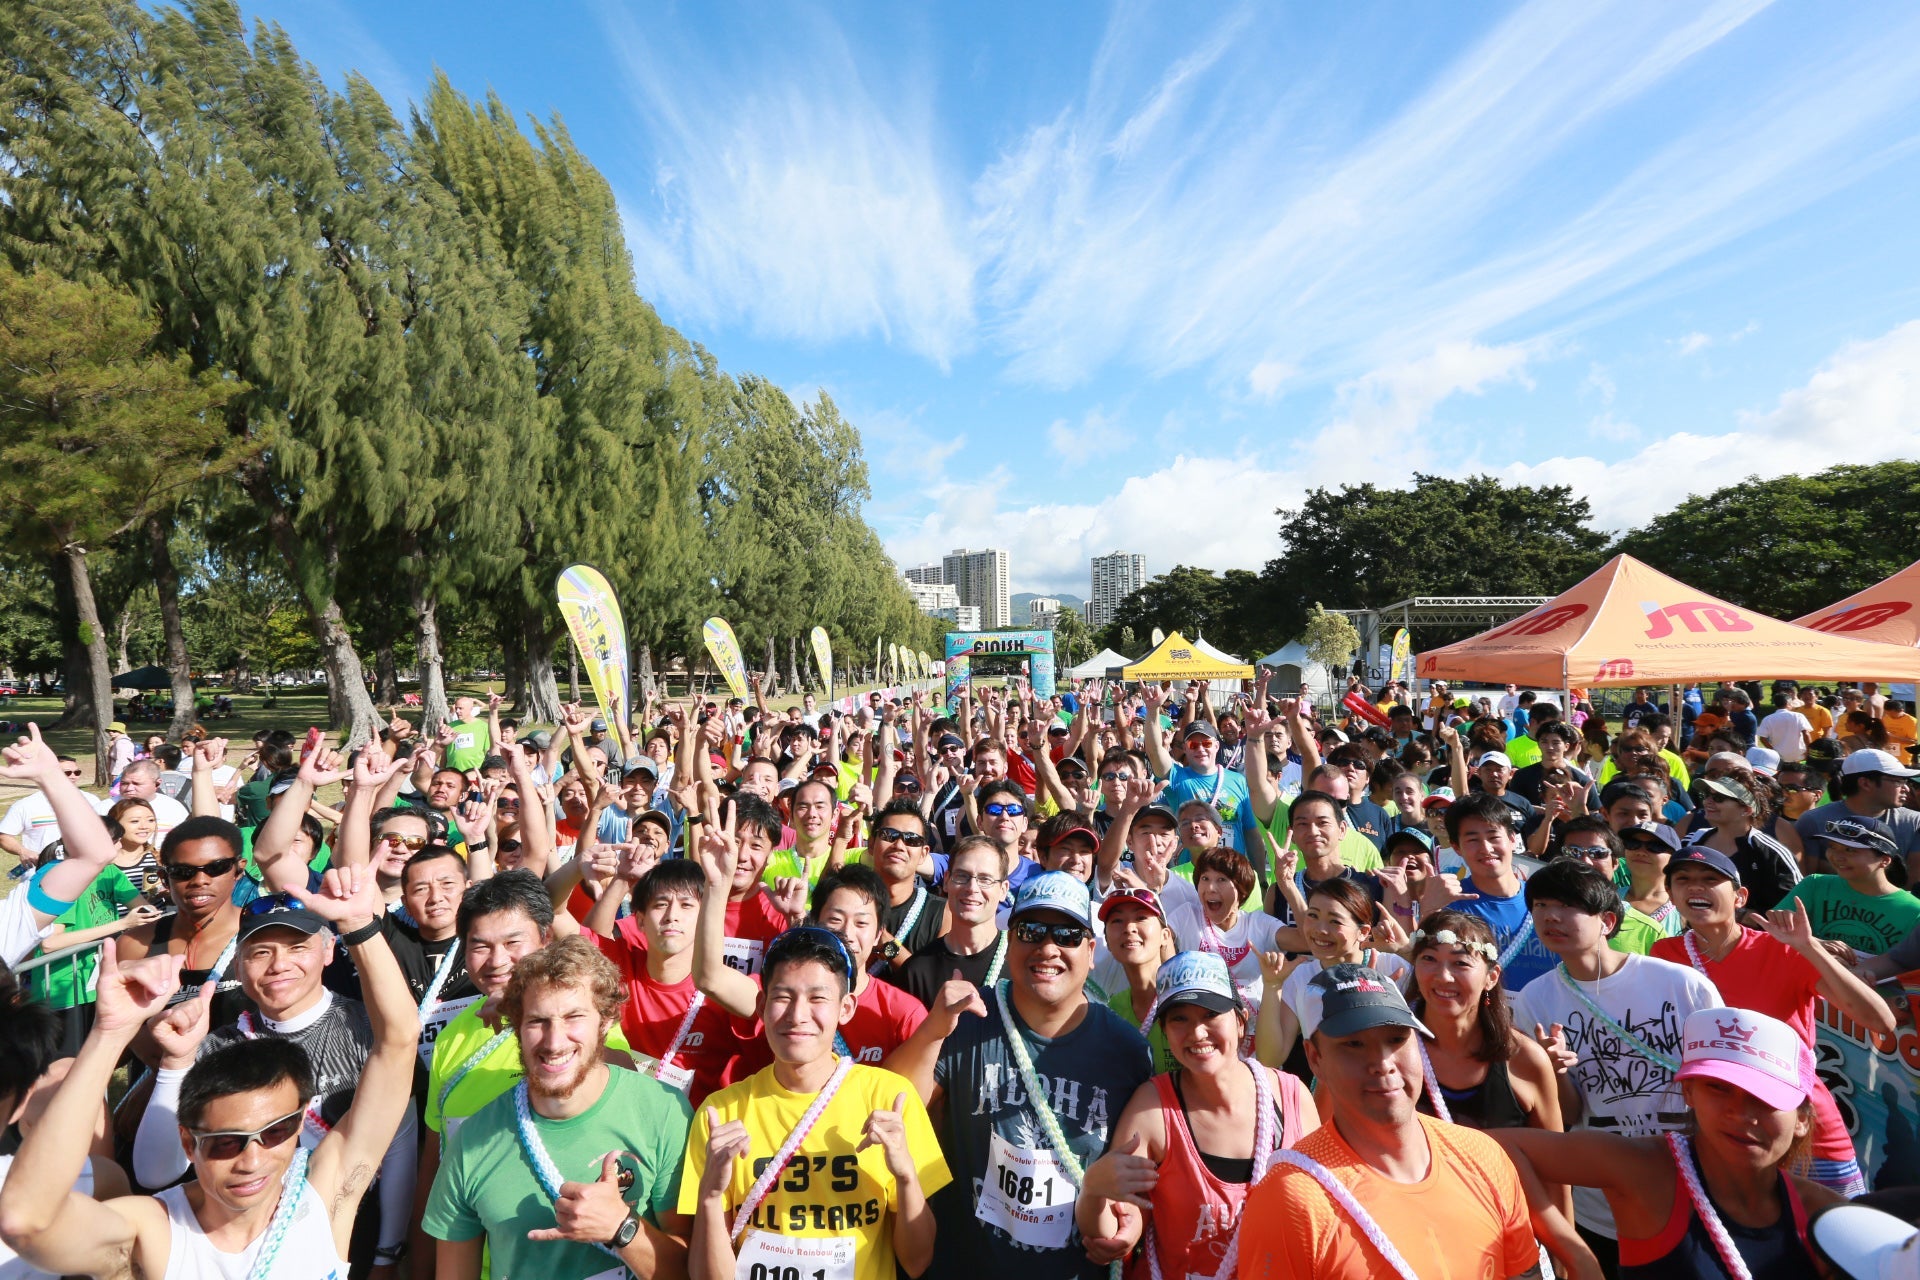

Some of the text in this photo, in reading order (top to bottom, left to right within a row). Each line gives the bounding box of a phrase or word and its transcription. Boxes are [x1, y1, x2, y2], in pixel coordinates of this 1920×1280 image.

[1484, 604, 1589, 641] JTB
[1640, 601, 1754, 639] JTB
[973, 640, 1025, 652] FINISH
[1635, 641, 1688, 650] Perfect
[1593, 658, 1634, 683] JTB
[1024, 873, 1082, 902] Aloha
[1159, 955, 1219, 994] Aloha
[856, 1045, 883, 1063] JTB
[1687, 1040, 1792, 1072] BLESSED
[1003, 1148, 1032, 1166] Honolulu
[997, 1164, 1054, 1207] 168-1
[789, 1198, 880, 1231] STARS
[1010, 1208, 1039, 1224] EKIDEN
[759, 1241, 833, 1257] Honolulu Rainbow
